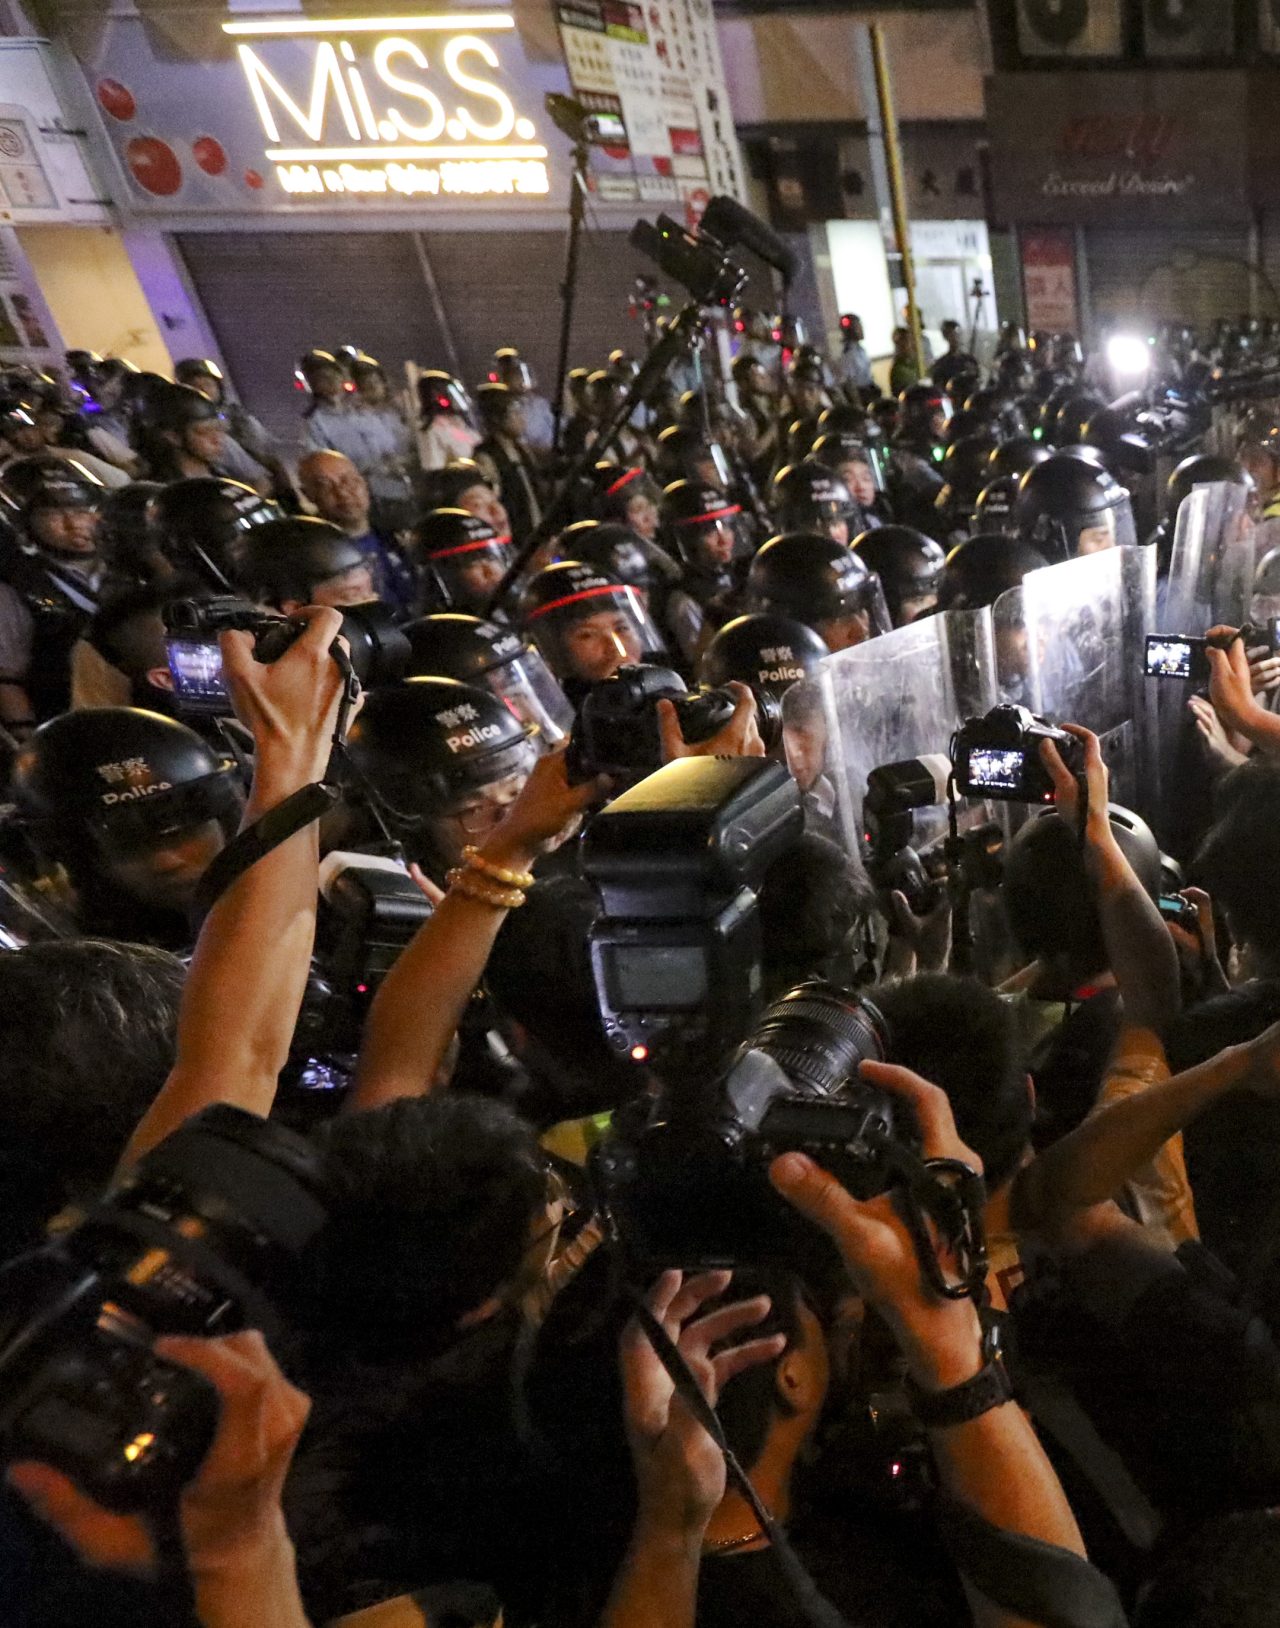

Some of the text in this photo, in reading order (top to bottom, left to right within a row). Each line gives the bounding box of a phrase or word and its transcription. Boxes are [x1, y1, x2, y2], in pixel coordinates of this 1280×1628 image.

[758, 667, 805, 684] Police
[446, 723, 502, 753] Police
[101, 781, 173, 805] Police
